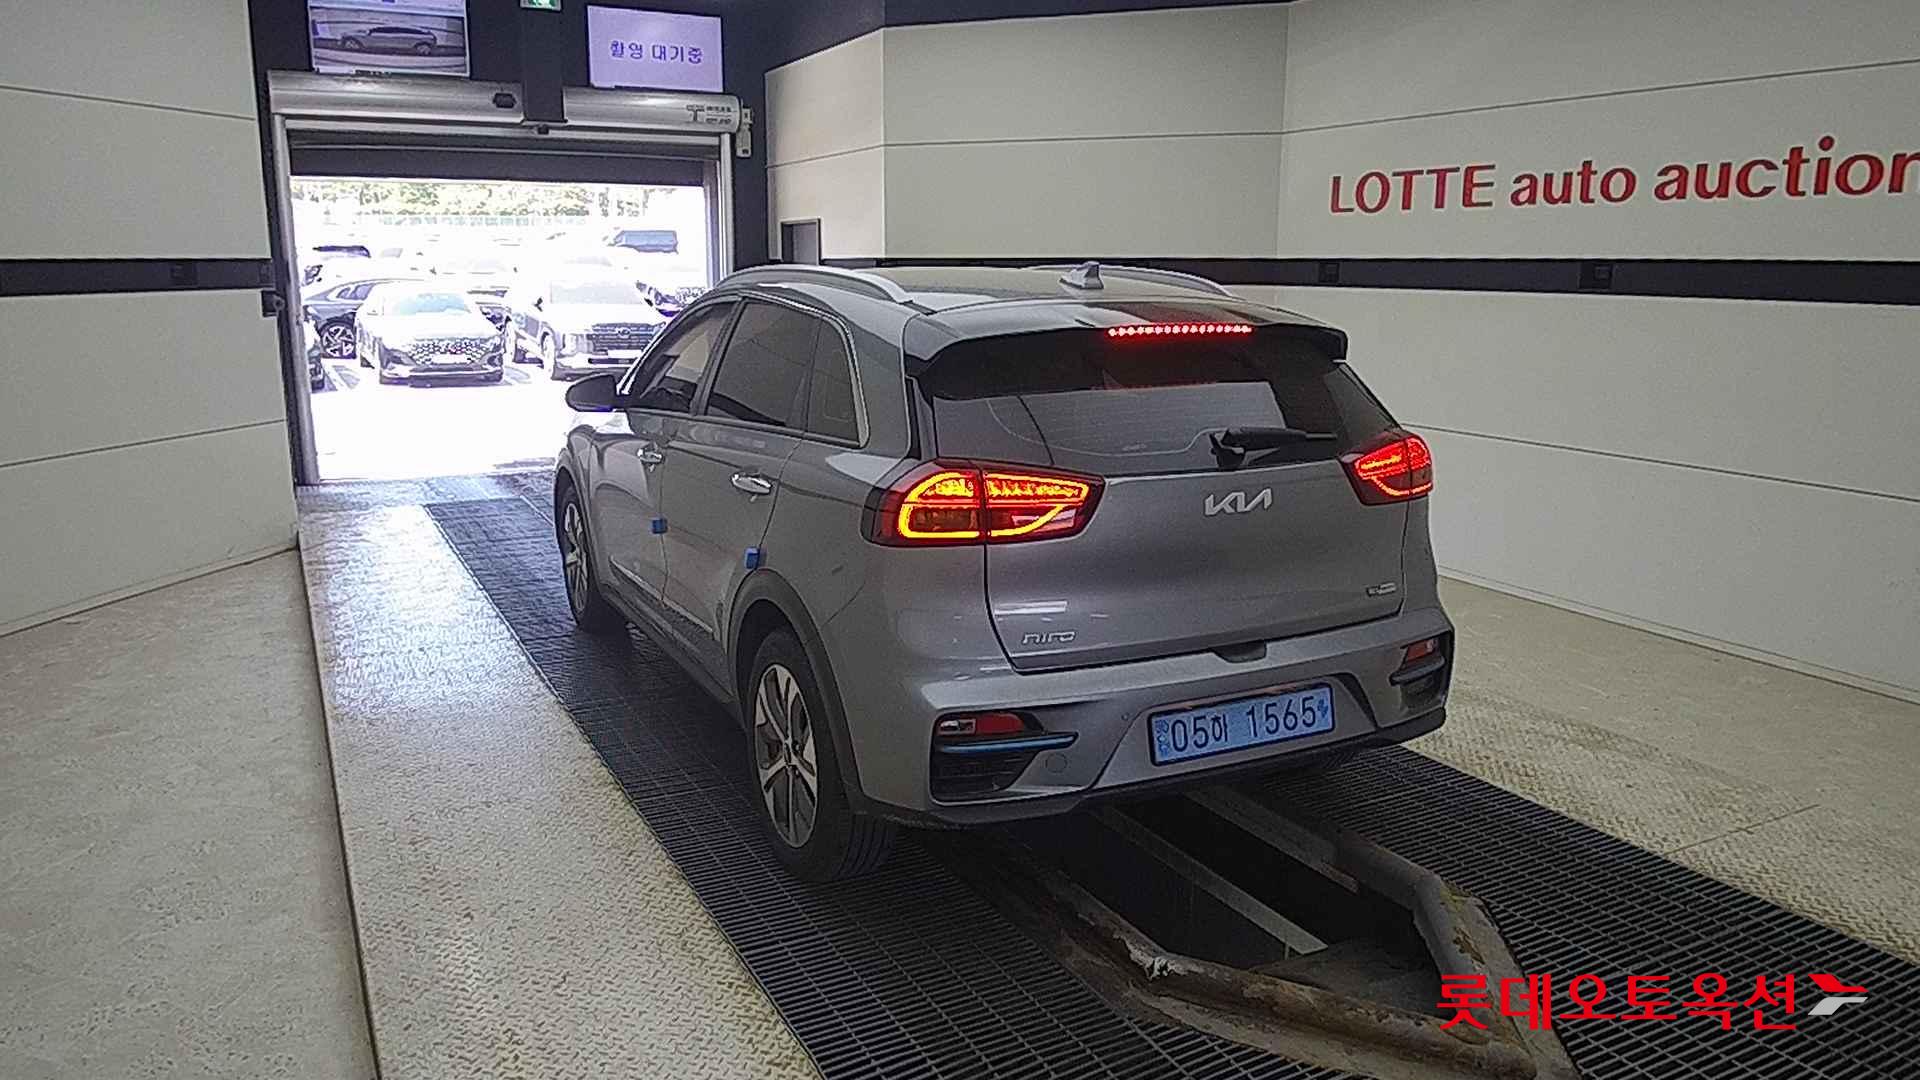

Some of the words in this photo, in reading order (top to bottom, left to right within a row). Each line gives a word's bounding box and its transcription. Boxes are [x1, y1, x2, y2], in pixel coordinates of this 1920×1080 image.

[651, 44, 702, 64] 대기중
[1330, 164, 1496, 214] LOTTE
[1509, 160, 1637, 207] auto
[1204, 488, 1272, 516] KIA
[1171, 714, 1228, 752] 05하
[1246, 696, 1316, 738] 1565
